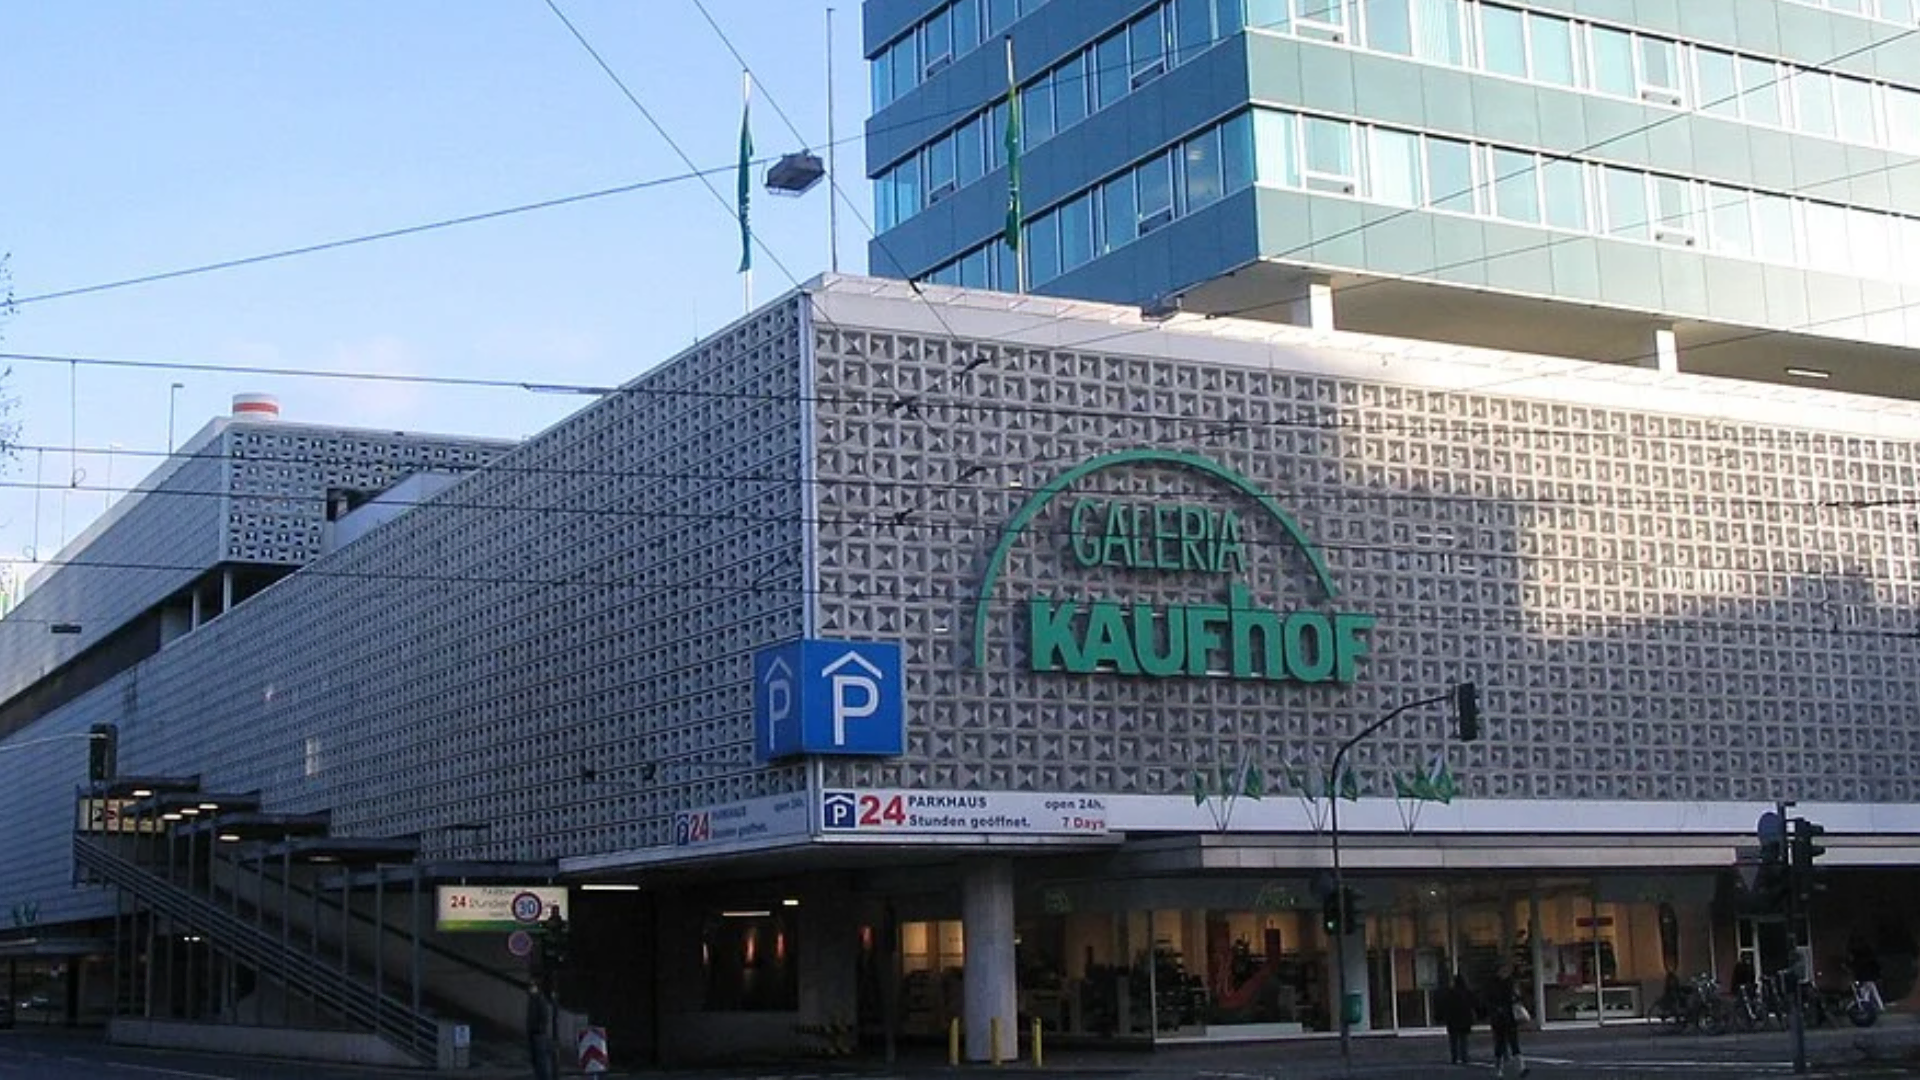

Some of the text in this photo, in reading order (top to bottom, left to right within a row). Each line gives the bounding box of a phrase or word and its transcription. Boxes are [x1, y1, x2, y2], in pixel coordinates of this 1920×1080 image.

[1071, 497, 1246, 572] GALERIA
[769, 679, 791, 751] P
[832, 674, 879, 746] P
[859, 795, 906, 826] 24
[908, 795, 988, 809] PARKHAUS
[1045, 799, 1105, 811] open 24h.
[833, 803, 847, 825] P
[909, 814, 1031, 830] Stunden geöffnet.
[1062, 817, 1106, 830] 7 Days
[690, 813, 709, 840] 24
[450, 895, 467, 908] 24
[519, 899, 537, 915] 30
